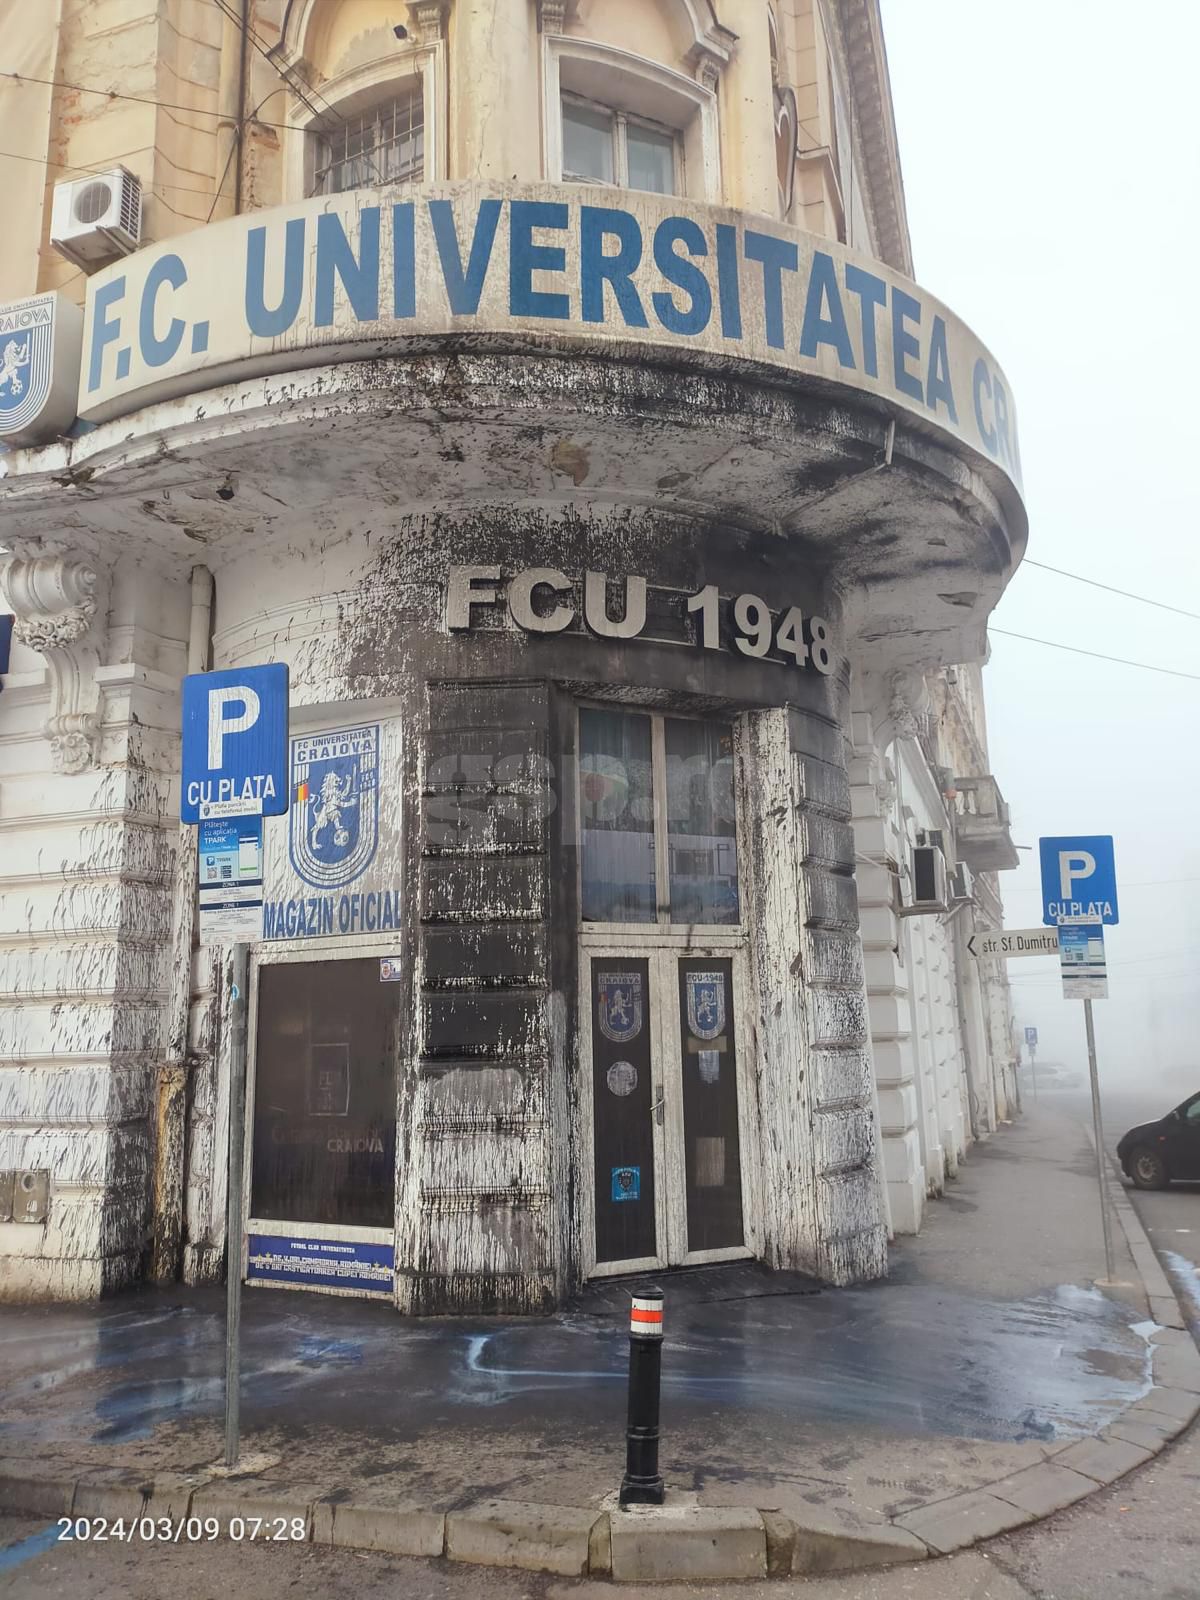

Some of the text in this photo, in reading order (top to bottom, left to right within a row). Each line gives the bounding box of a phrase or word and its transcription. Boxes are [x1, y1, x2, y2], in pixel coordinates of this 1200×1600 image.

[88, 199, 1020, 479] F.C. UNIVERSITATEA CR
[447, 565, 838, 676] FCU 1948
[208, 686, 260, 771] P
[298, 730, 372, 750] FC UNIVERSITATEA
[297, 739, 373, 762] CRAIOVA
[187, 774, 276, 806] CU PLATA
[204, 836, 226, 845] TPARK
[1058, 850, 1096, 900] P
[263, 890, 400, 939] MAGAZIN OFICIAL
[1048, 901, 1113, 917] CU PLATA
[983, 937, 999, 953] str.
[1002, 937, 1015, 952] Sf.
[1017, 934, 1058, 951] Dumitru
[688, 974, 702, 982] FCU
[327, 1139, 384, 1153] CRAIOVA
